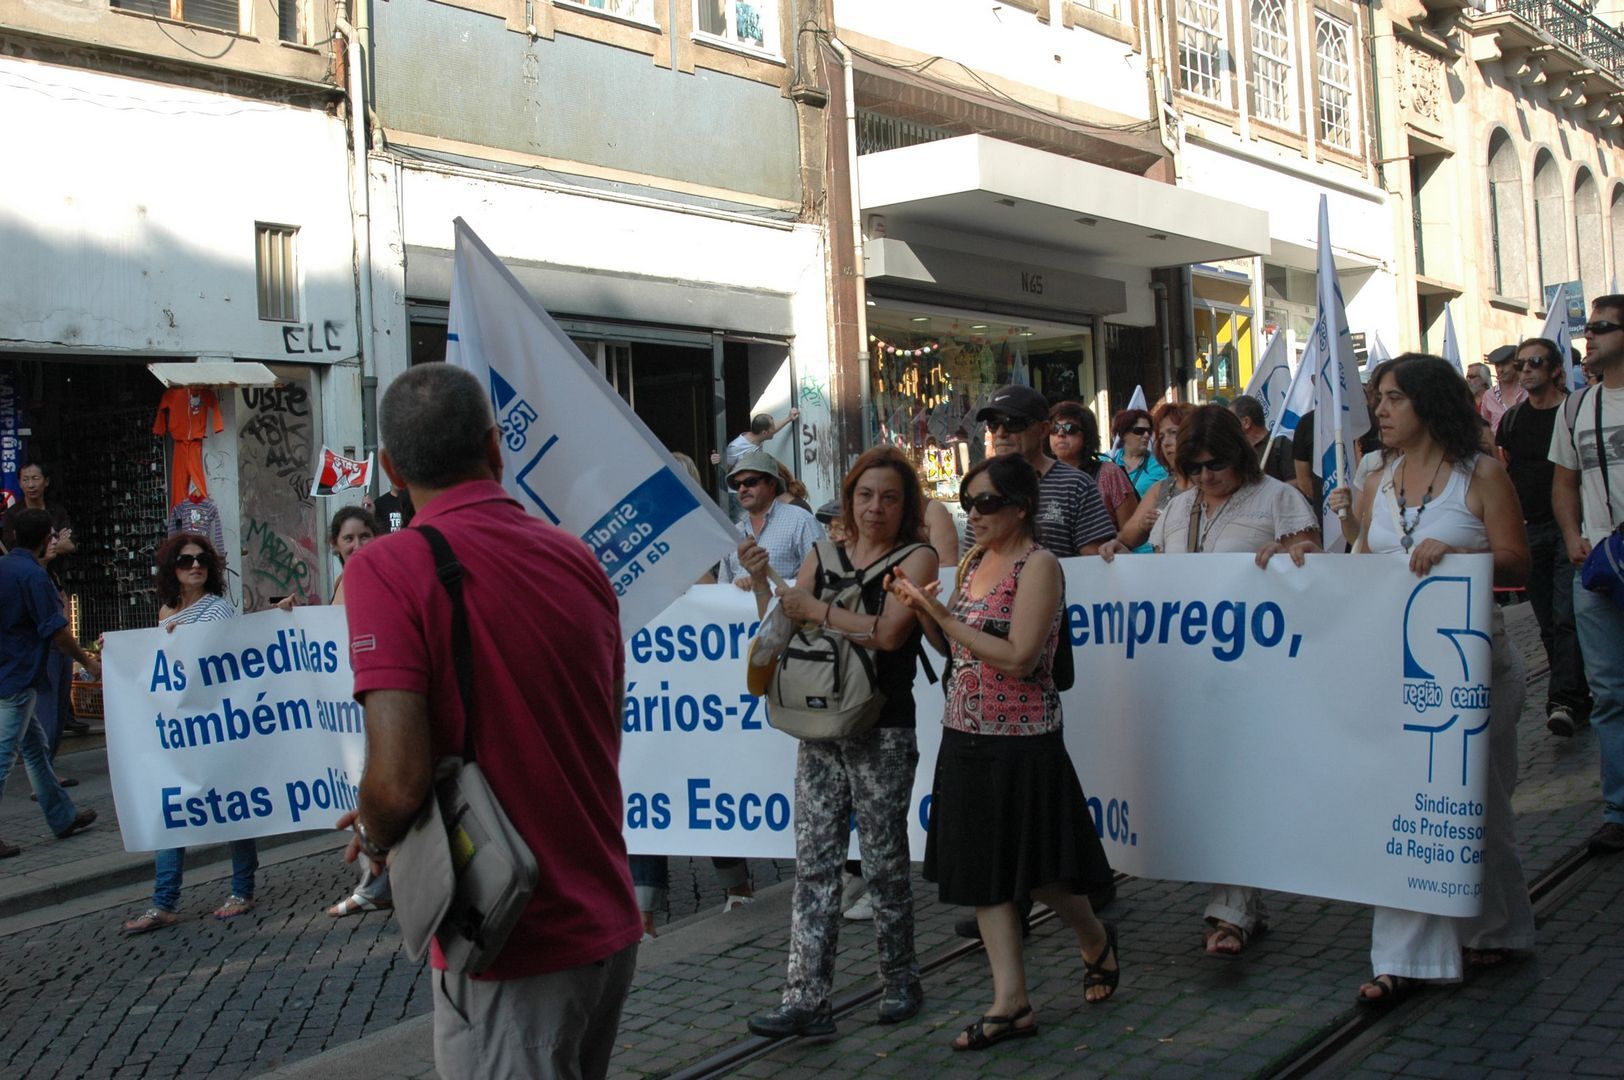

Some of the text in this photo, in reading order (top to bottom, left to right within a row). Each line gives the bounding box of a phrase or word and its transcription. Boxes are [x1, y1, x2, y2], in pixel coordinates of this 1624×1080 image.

[631, 621, 761, 664] essor
[1066, 600, 1303, 662] emprego,
[150, 628, 338, 692] As medidas
[622, 680, 768, 733] ários-z
[1403, 681, 1442, 712] região
[156, 691, 313, 749] também
[161, 785, 273, 829] Estas
[687, 778, 796, 831] Esco
[1392, 814, 1416, 834] dos
[1415, 792, 1483, 817] Sindicato
[1386, 837, 1403, 856] da
[1407, 839, 1455, 865] Região
